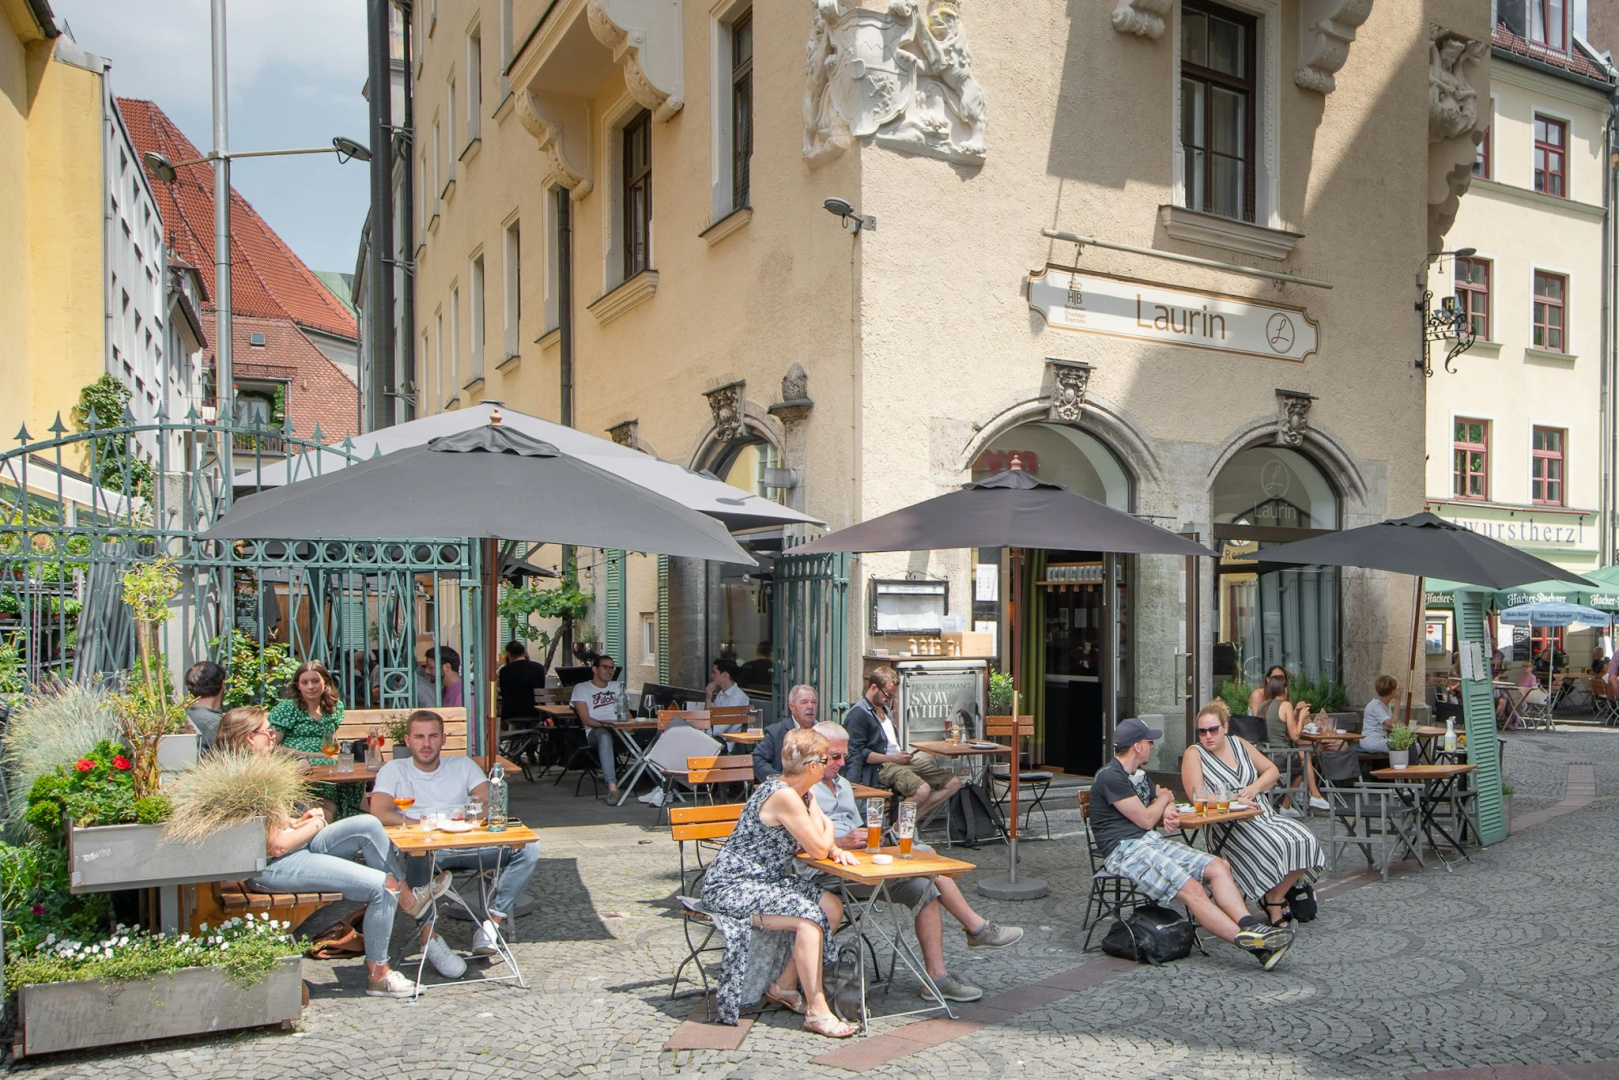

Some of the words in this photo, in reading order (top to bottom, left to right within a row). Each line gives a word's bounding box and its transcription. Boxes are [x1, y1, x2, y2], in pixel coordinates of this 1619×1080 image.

[1136, 293, 1226, 340] Laurin
[1254, 501, 1297, 520] Laurin
[1453, 516, 1583, 543] twurstherzl
[911, 682, 937, 691] FREDRIK
[911, 691, 949, 705] SNOW
